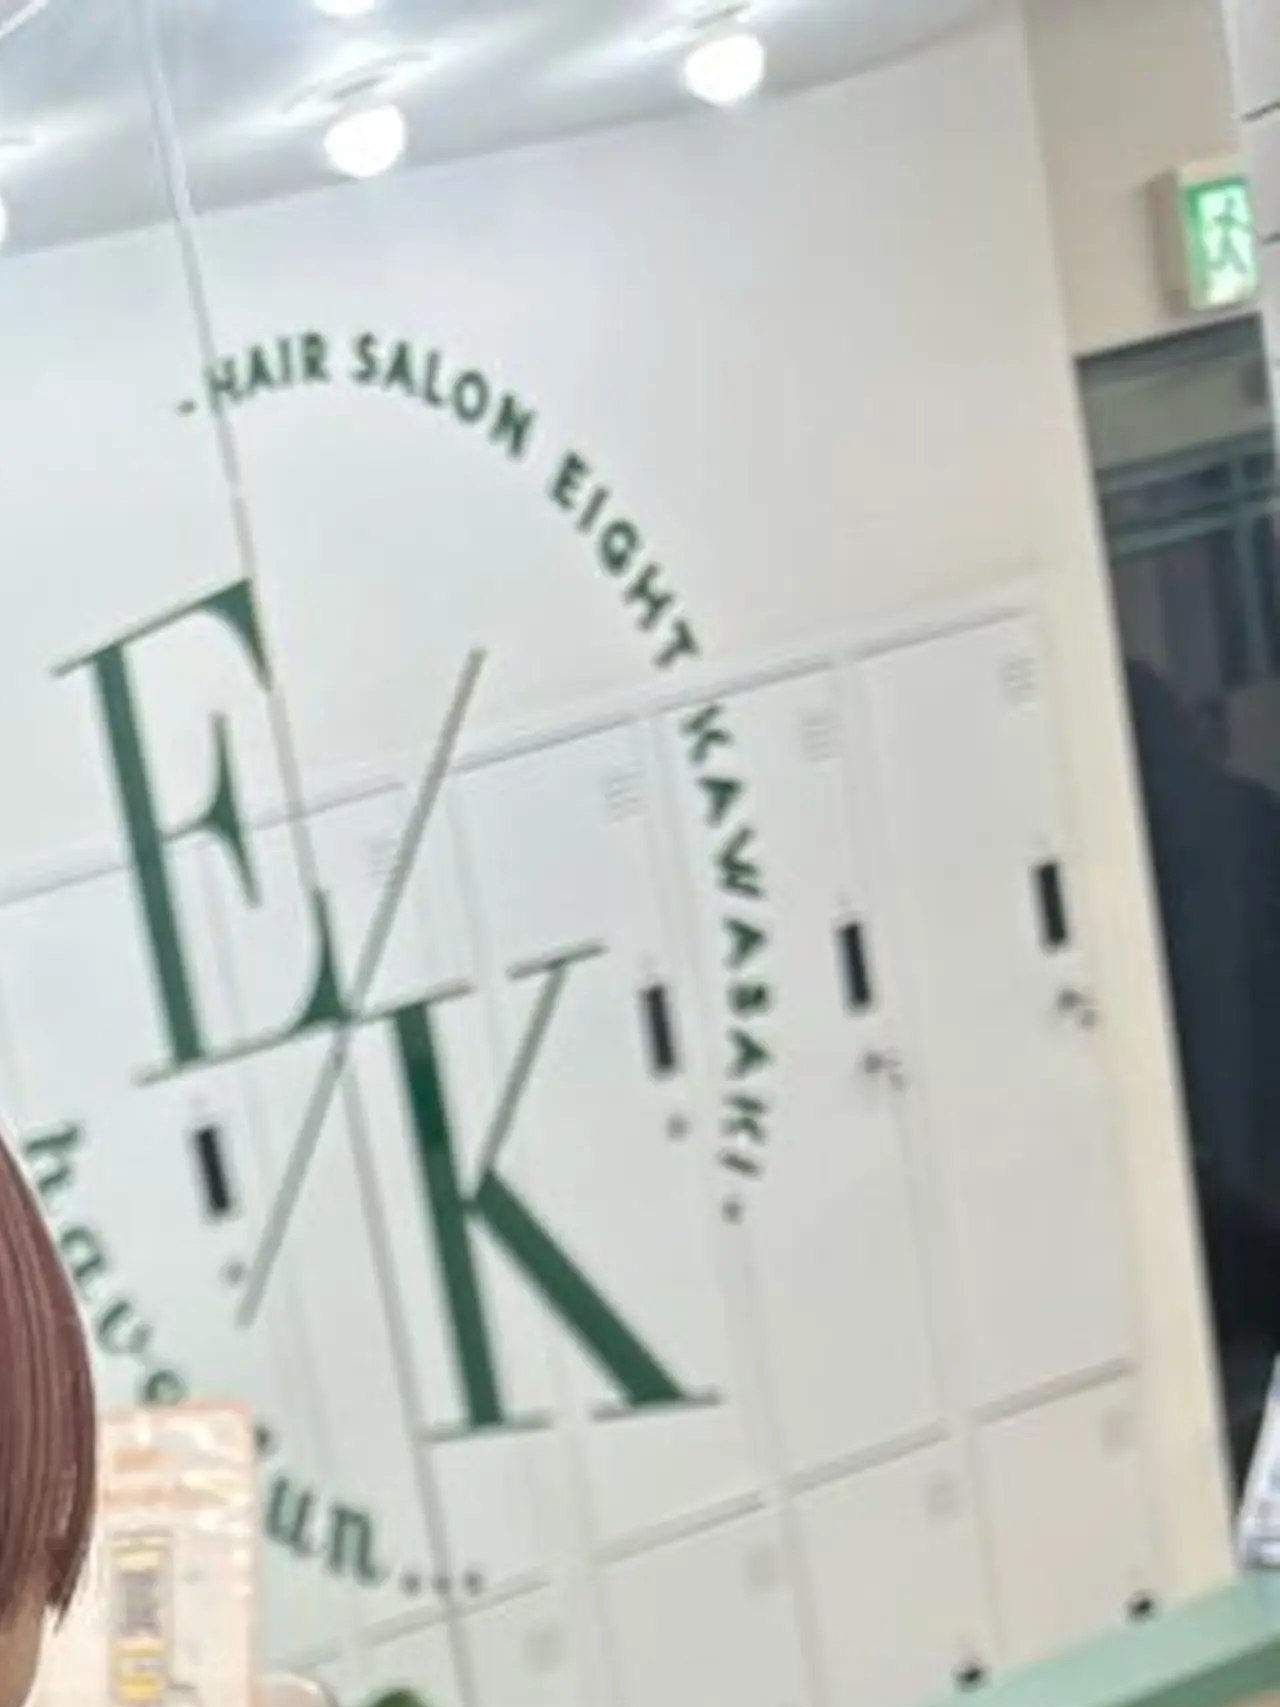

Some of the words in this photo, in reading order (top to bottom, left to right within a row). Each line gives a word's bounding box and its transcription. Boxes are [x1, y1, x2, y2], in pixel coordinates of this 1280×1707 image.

[350, 332, 536, 458] SALON
[551, 453, 701, 671] EIGHT
[254, 1422, 484, 1597] un...
